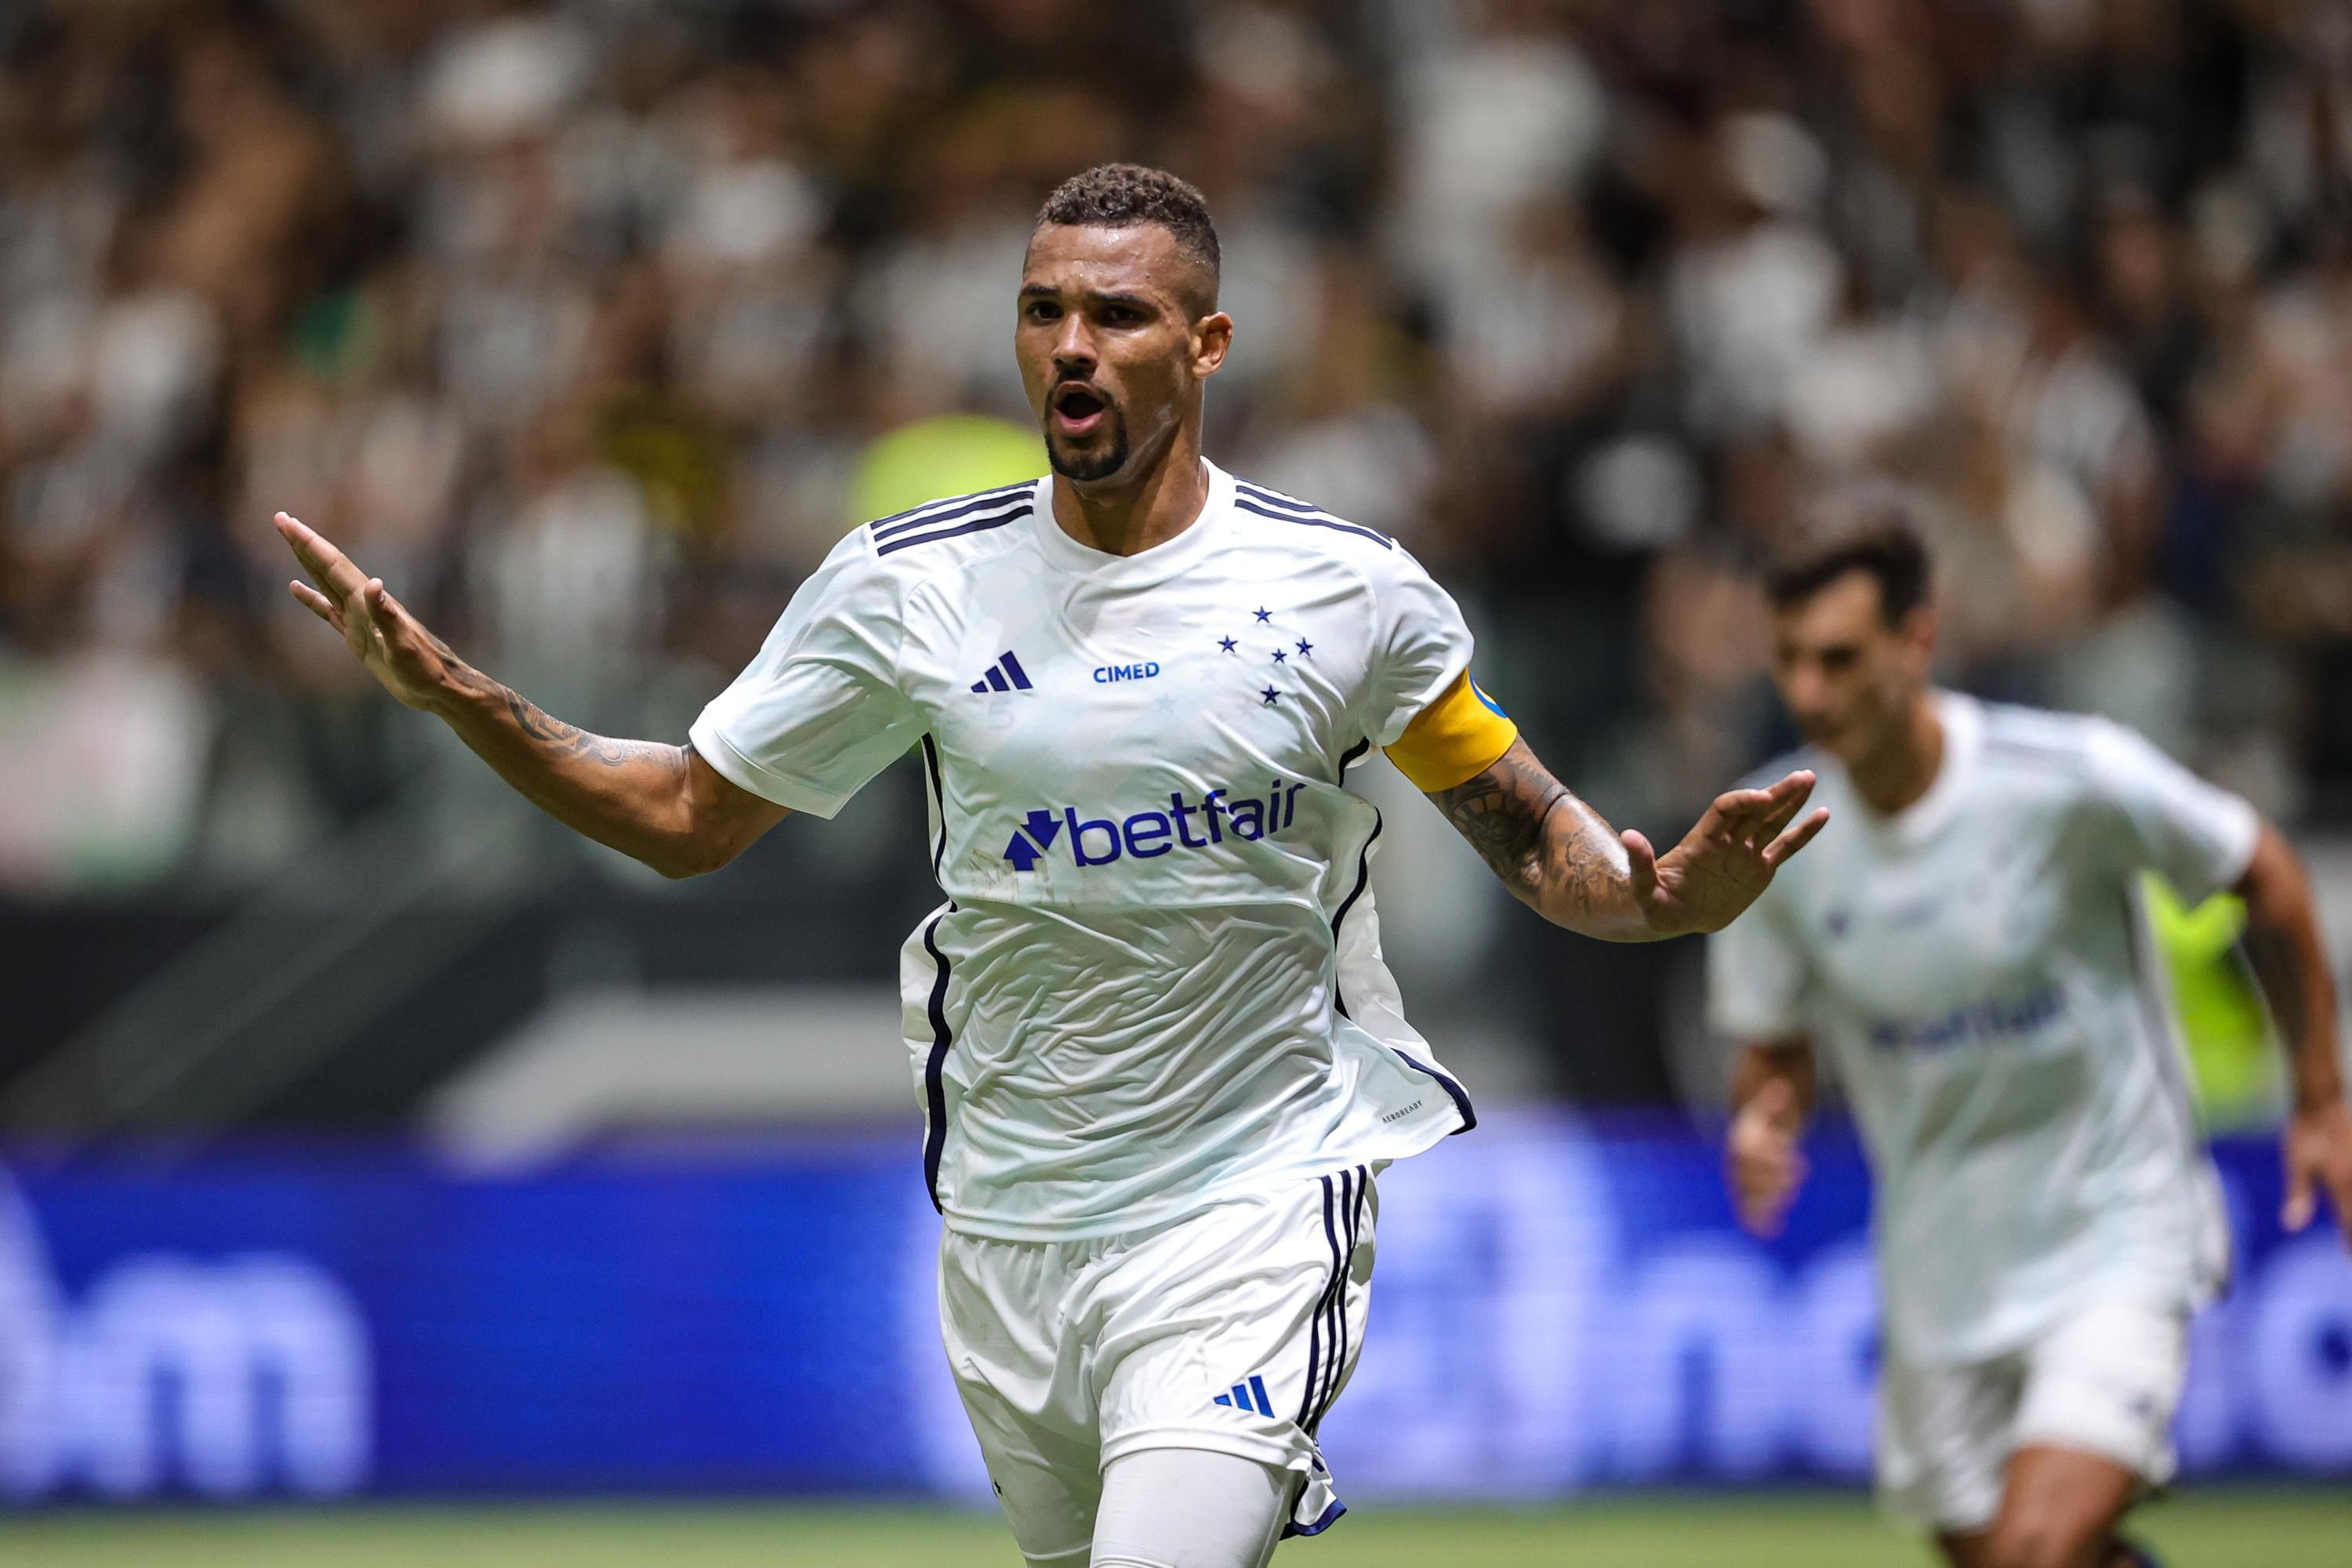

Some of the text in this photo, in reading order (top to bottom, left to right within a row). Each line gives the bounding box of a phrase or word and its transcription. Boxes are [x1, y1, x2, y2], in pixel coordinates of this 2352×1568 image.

[1093, 662, 1160, 684] CIMED
[1065, 779, 1307, 868] betfair
[1381, 1099, 1423, 1124] AEROREADY
